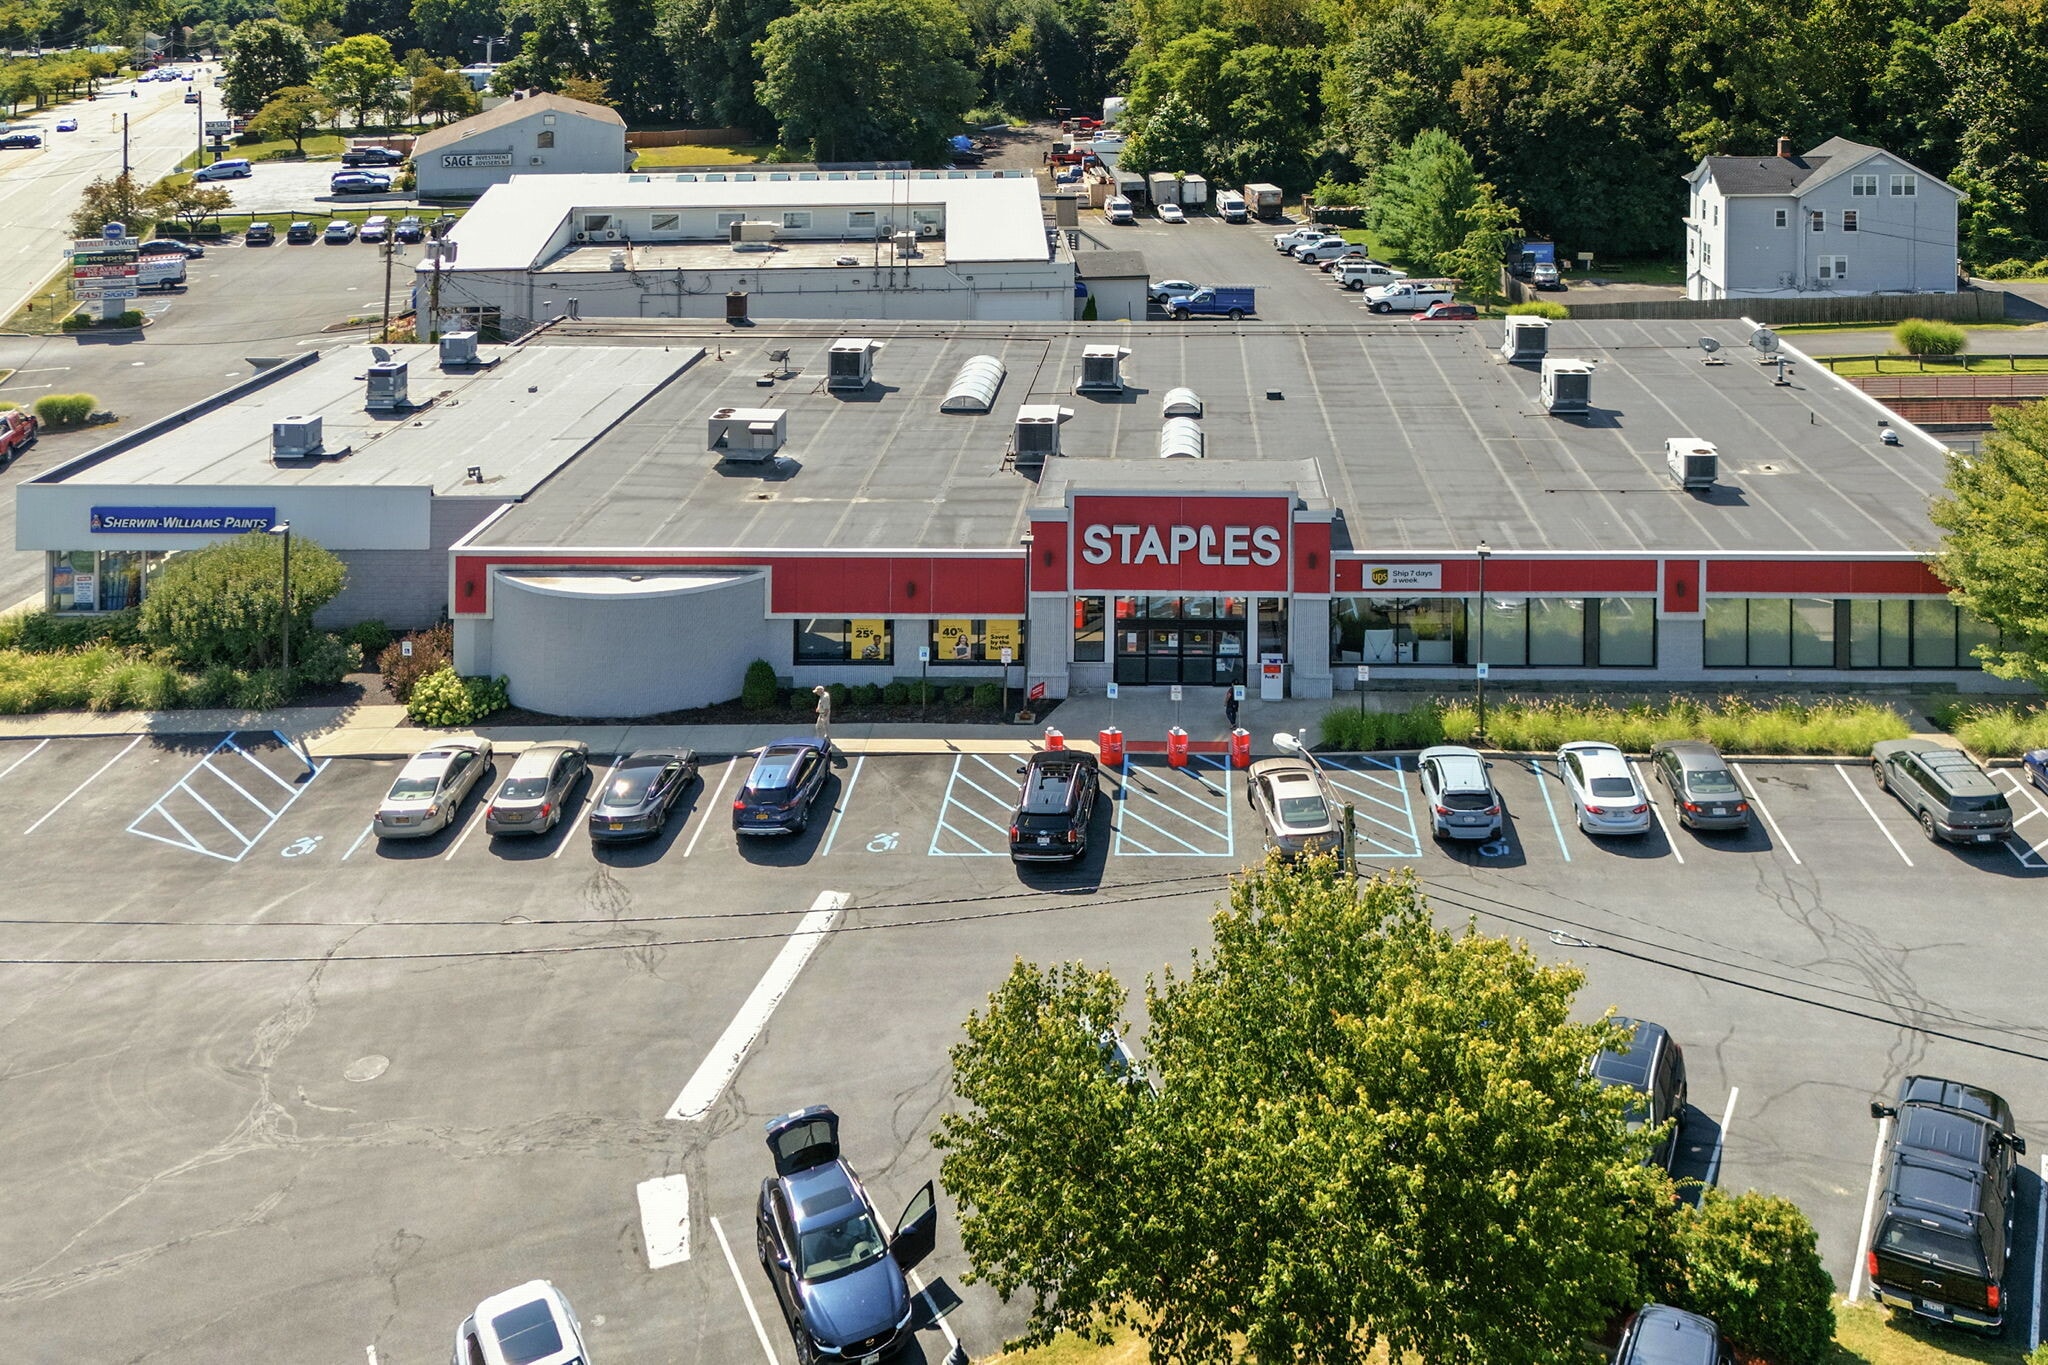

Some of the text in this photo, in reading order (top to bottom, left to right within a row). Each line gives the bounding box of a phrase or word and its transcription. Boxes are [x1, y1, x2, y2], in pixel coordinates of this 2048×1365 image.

[444, 156, 473, 167] SAGE
[77, 254, 134, 262] enterprise
[1082, 523, 1281, 566] STAPLES
[1373, 573, 1387, 583] ups
[1415, 570, 1433, 578] days
[855, 629, 874, 638] 25¢
[942, 627, 964, 637] 40%
